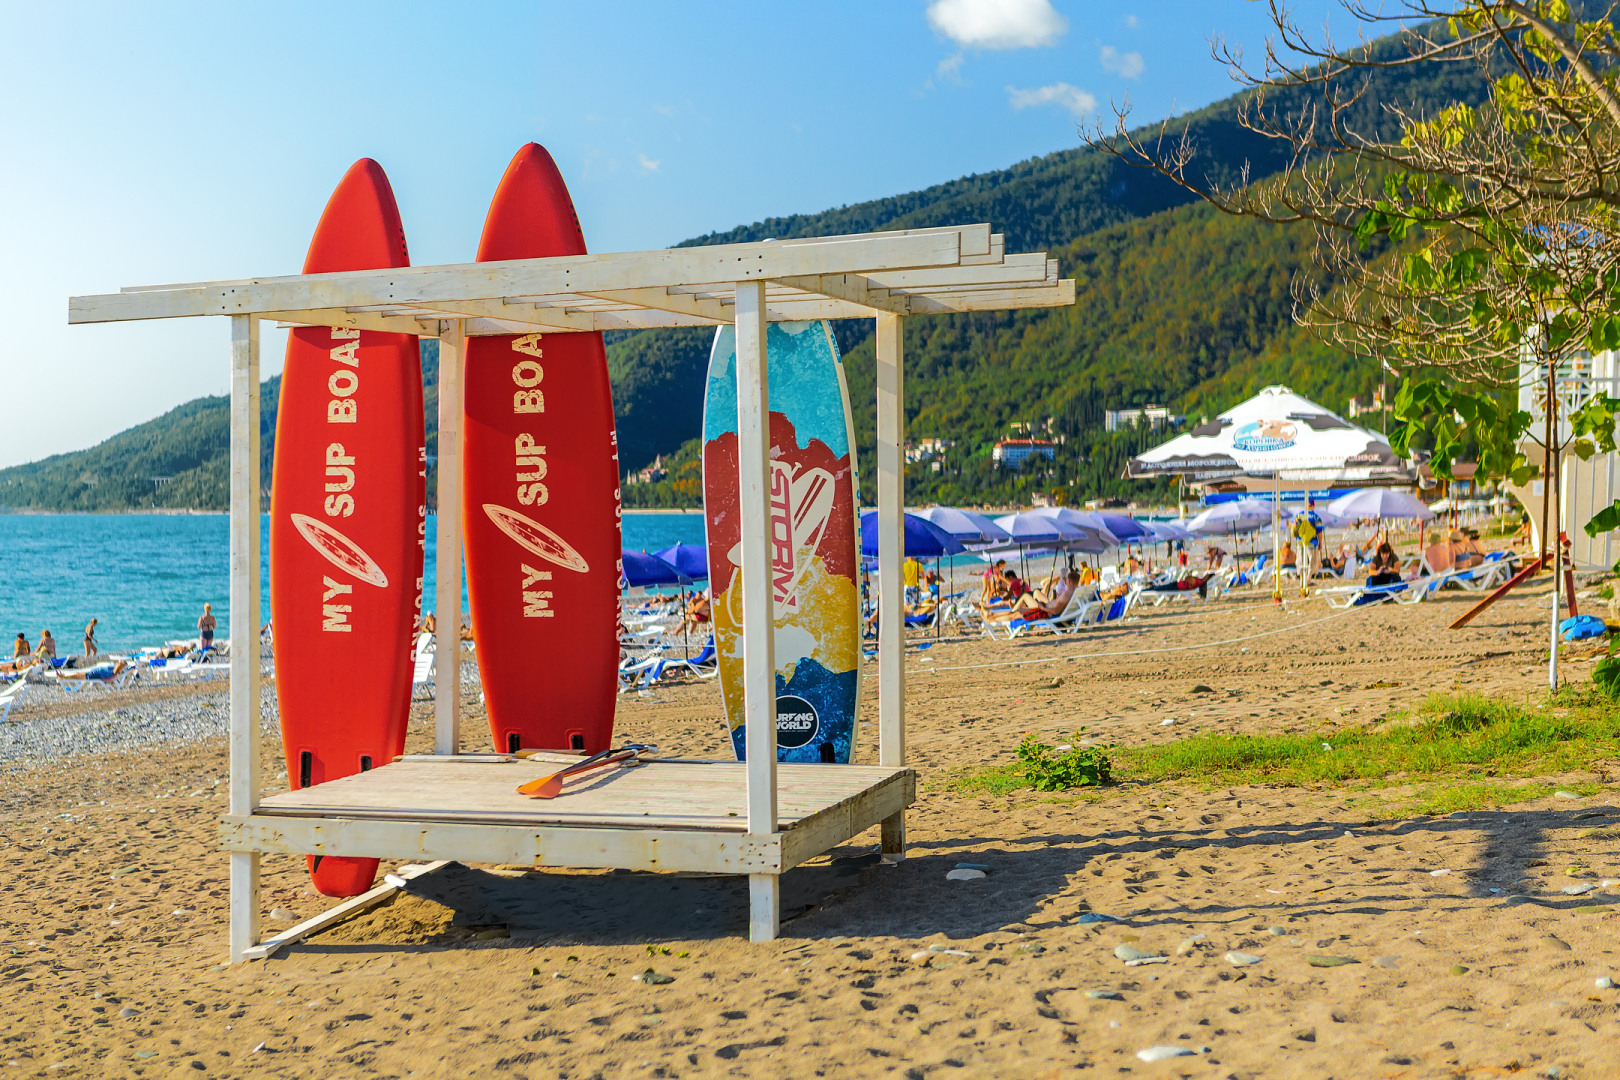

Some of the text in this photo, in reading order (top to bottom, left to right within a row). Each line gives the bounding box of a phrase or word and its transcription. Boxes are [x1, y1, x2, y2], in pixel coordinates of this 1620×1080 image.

[322, 327, 361, 632] MY SUP BOA
[511, 333, 554, 618] MY SUP BOA
[770, 466, 796, 607] STORM
